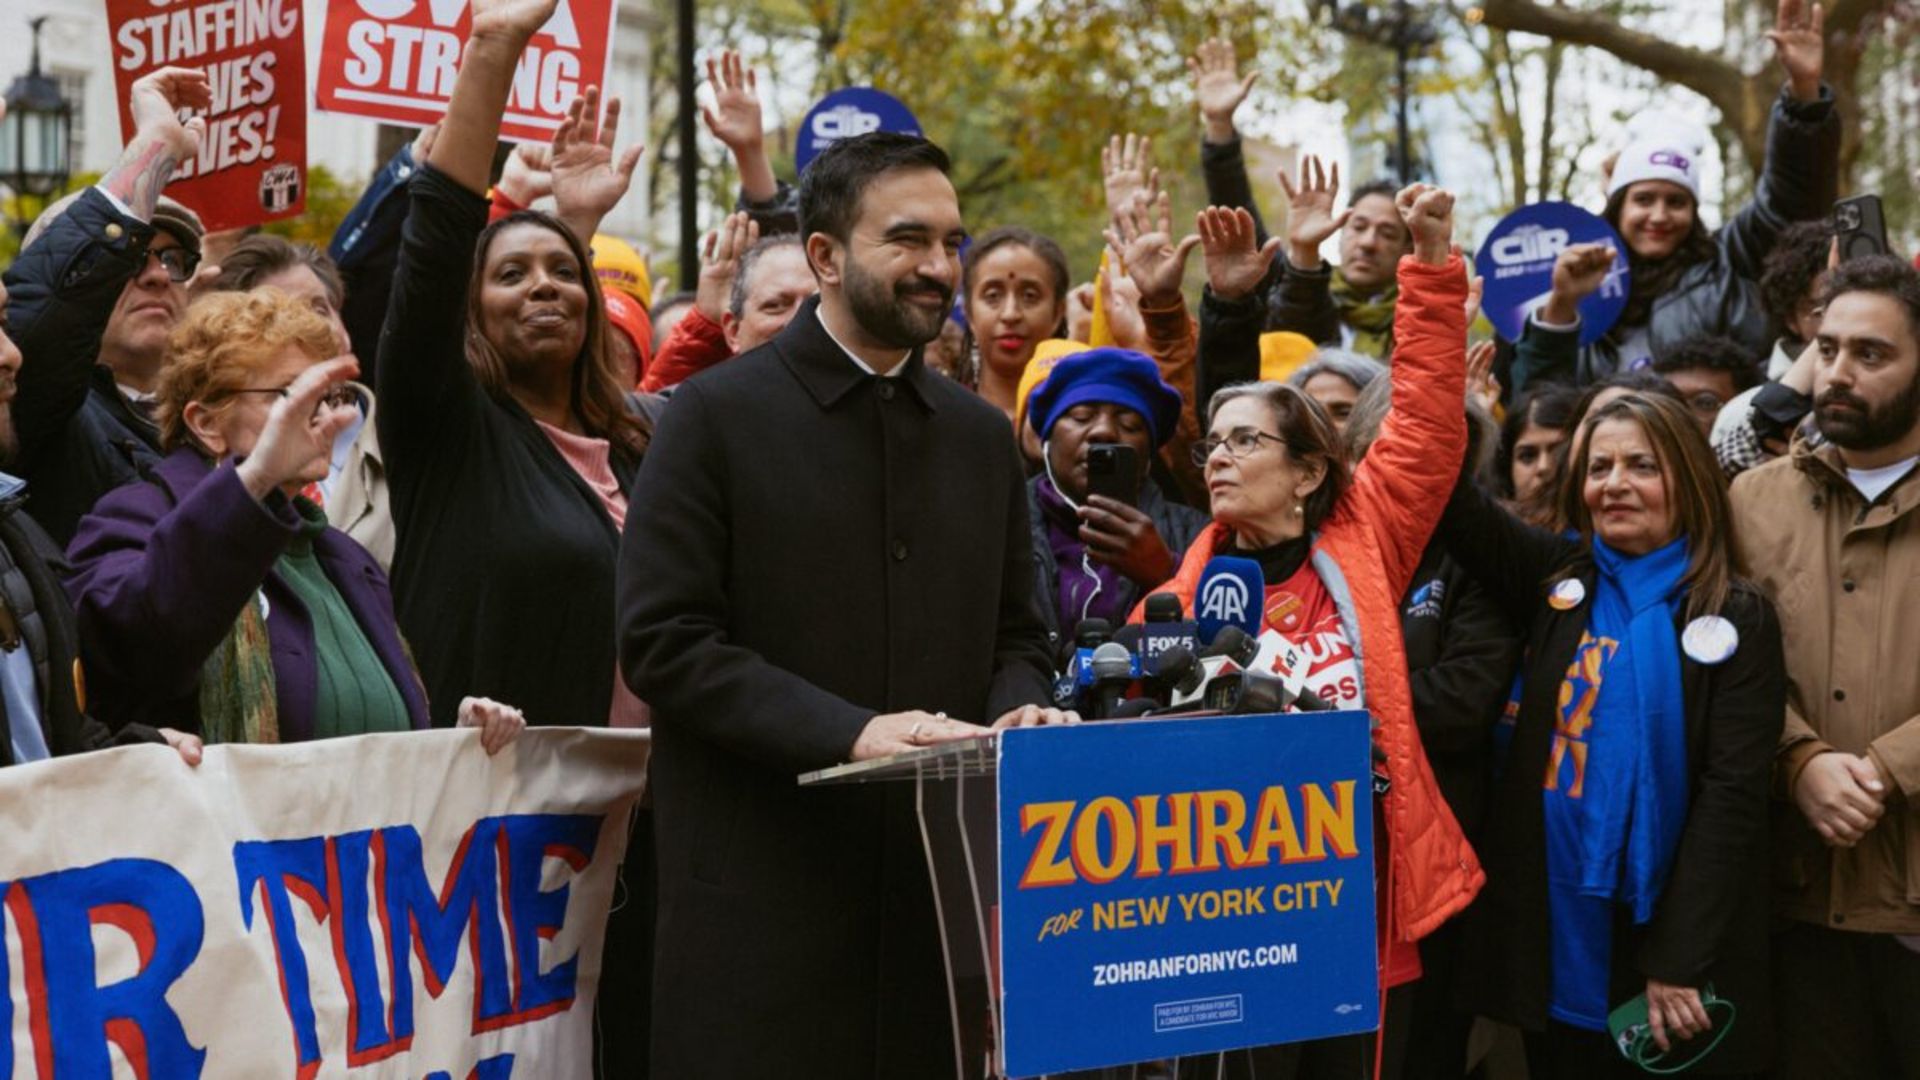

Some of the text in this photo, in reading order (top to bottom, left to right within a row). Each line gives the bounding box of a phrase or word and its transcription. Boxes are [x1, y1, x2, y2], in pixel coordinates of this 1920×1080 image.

[117, 0, 298, 71] STAFFING
[343, 19, 581, 115] STRNG
[1201, 586, 1247, 623] AA
[1018, 780, 1359, 890] ZOHRAN
[1037, 878, 1345, 942] FOR NEW YORK CITY
[232, 814, 608, 1080] TIME
[1093, 943, 1298, 986] ZOHRANFORNYC.COM
